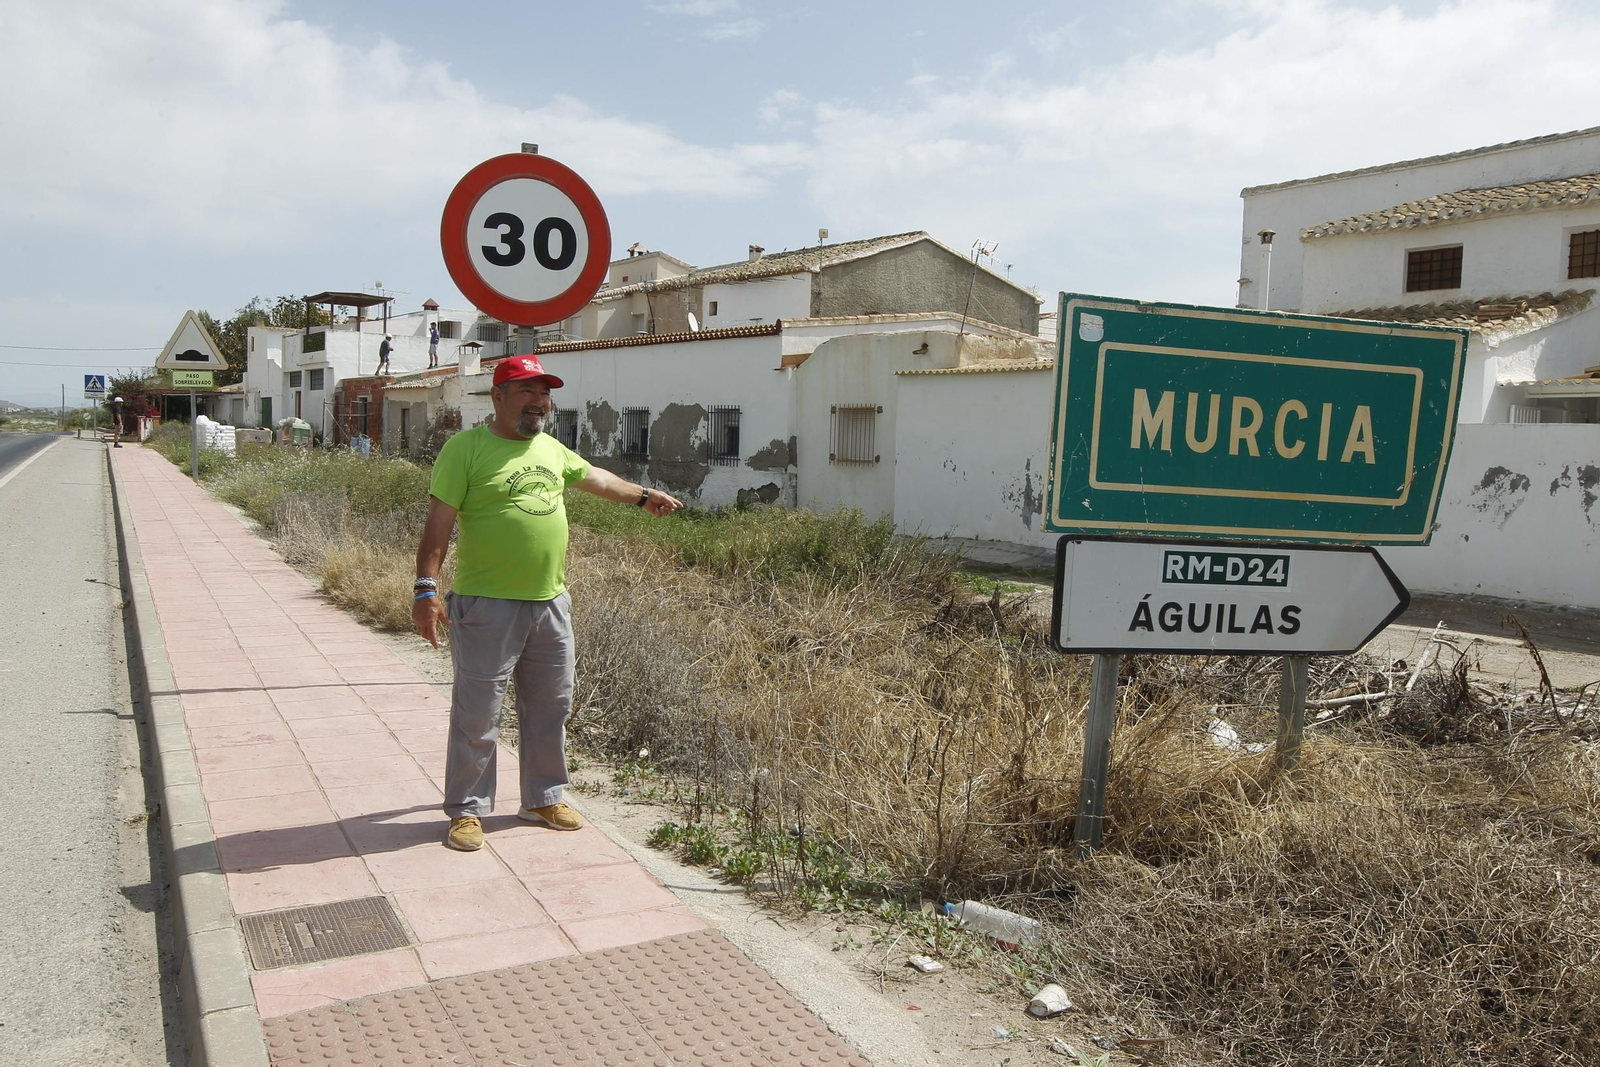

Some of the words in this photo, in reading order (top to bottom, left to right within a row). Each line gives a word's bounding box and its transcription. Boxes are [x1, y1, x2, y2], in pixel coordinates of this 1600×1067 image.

[482, 212, 576, 271] 30
[1130, 388, 1376, 465] MURCIA
[1165, 555, 1285, 583] RM-D24
[1128, 594, 1302, 635] ÁGUILAS
